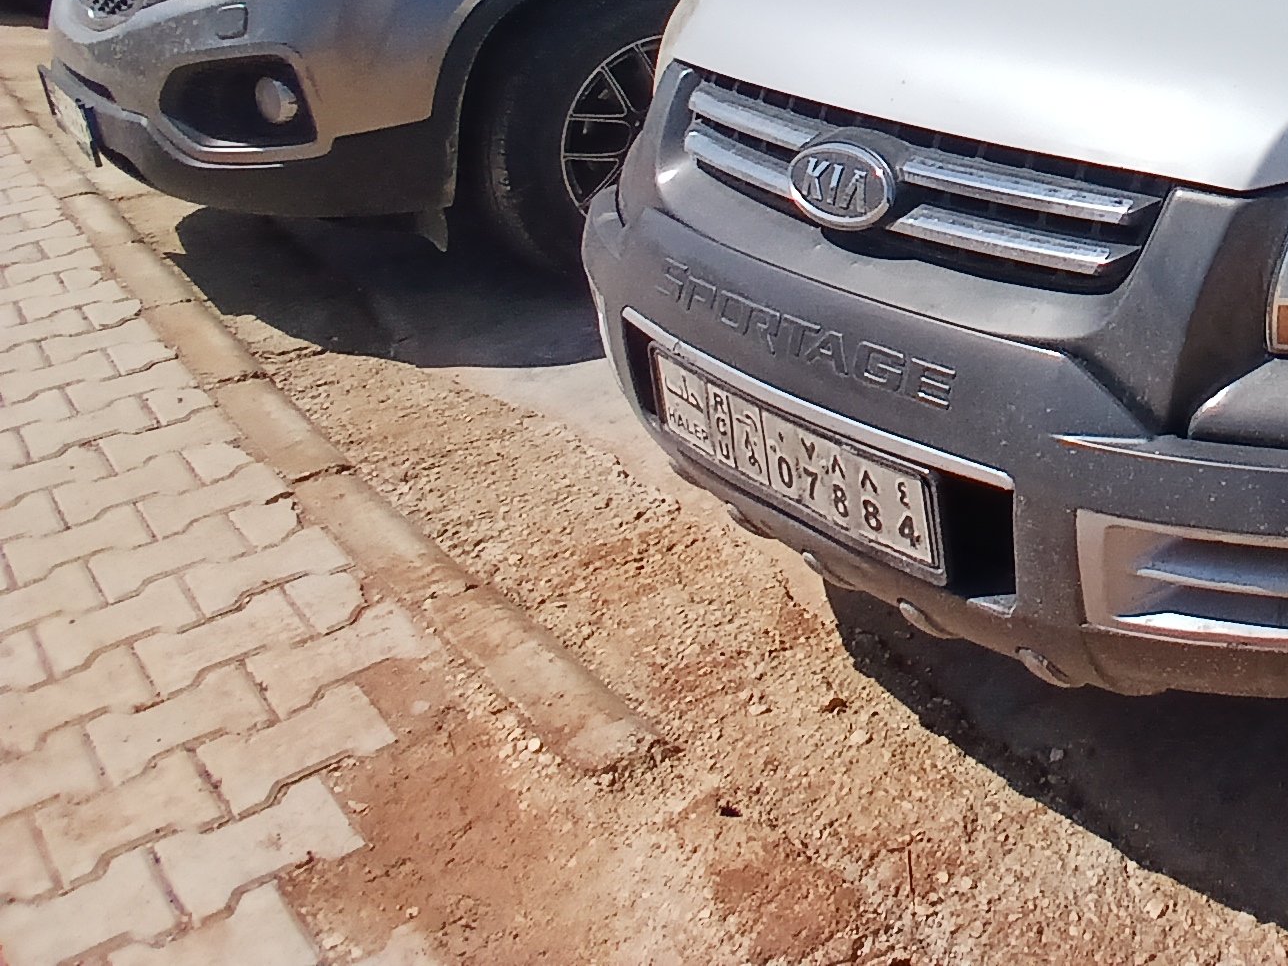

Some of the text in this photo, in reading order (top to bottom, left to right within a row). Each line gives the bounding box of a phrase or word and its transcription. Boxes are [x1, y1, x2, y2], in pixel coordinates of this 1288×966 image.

[801, 156, 868, 215] KIA
[656, 256, 956, 411] SPORTAGE
[665, 375, 704, 413] حلب
[777, 455, 921, 550] 07884
